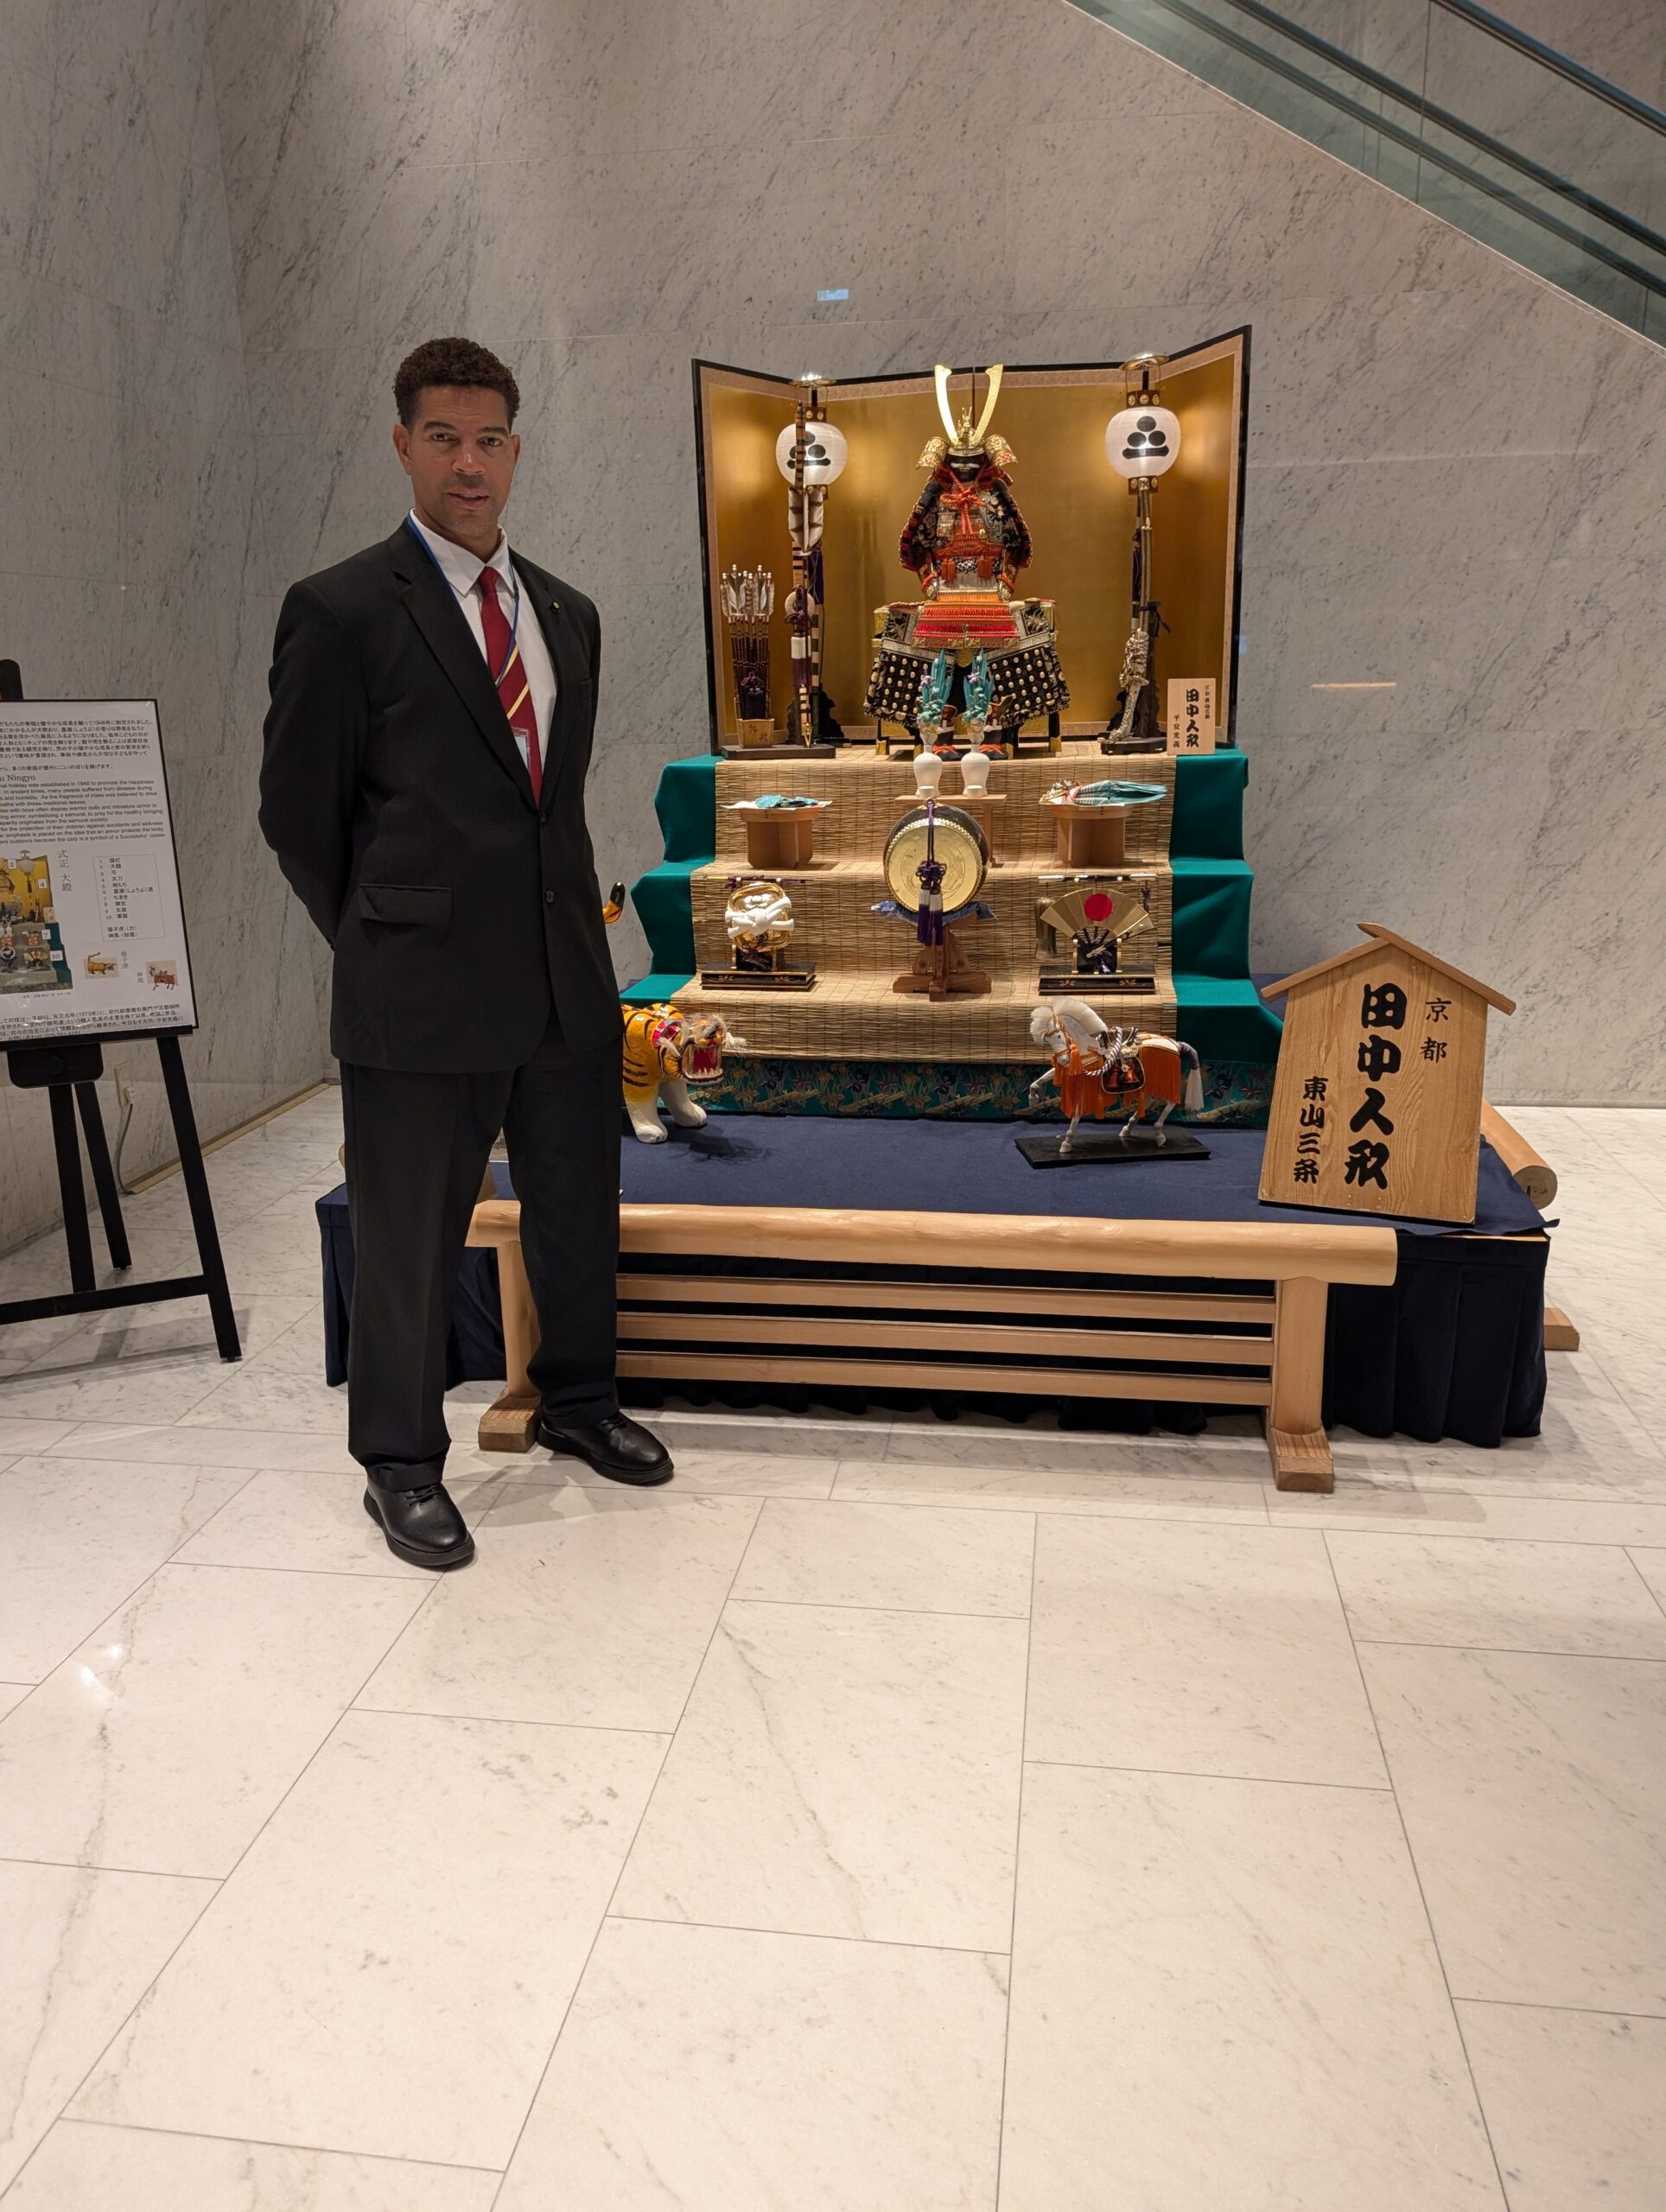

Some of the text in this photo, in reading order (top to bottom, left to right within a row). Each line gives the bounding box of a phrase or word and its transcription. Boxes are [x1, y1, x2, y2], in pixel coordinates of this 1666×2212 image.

[7, 774, 36, 782] Ningyo
[1419, 998, 1452, 1064] 京都
[1344, 982, 1407, 1190] 田中人形
[1293, 1077, 1329, 1184] 東山三条
